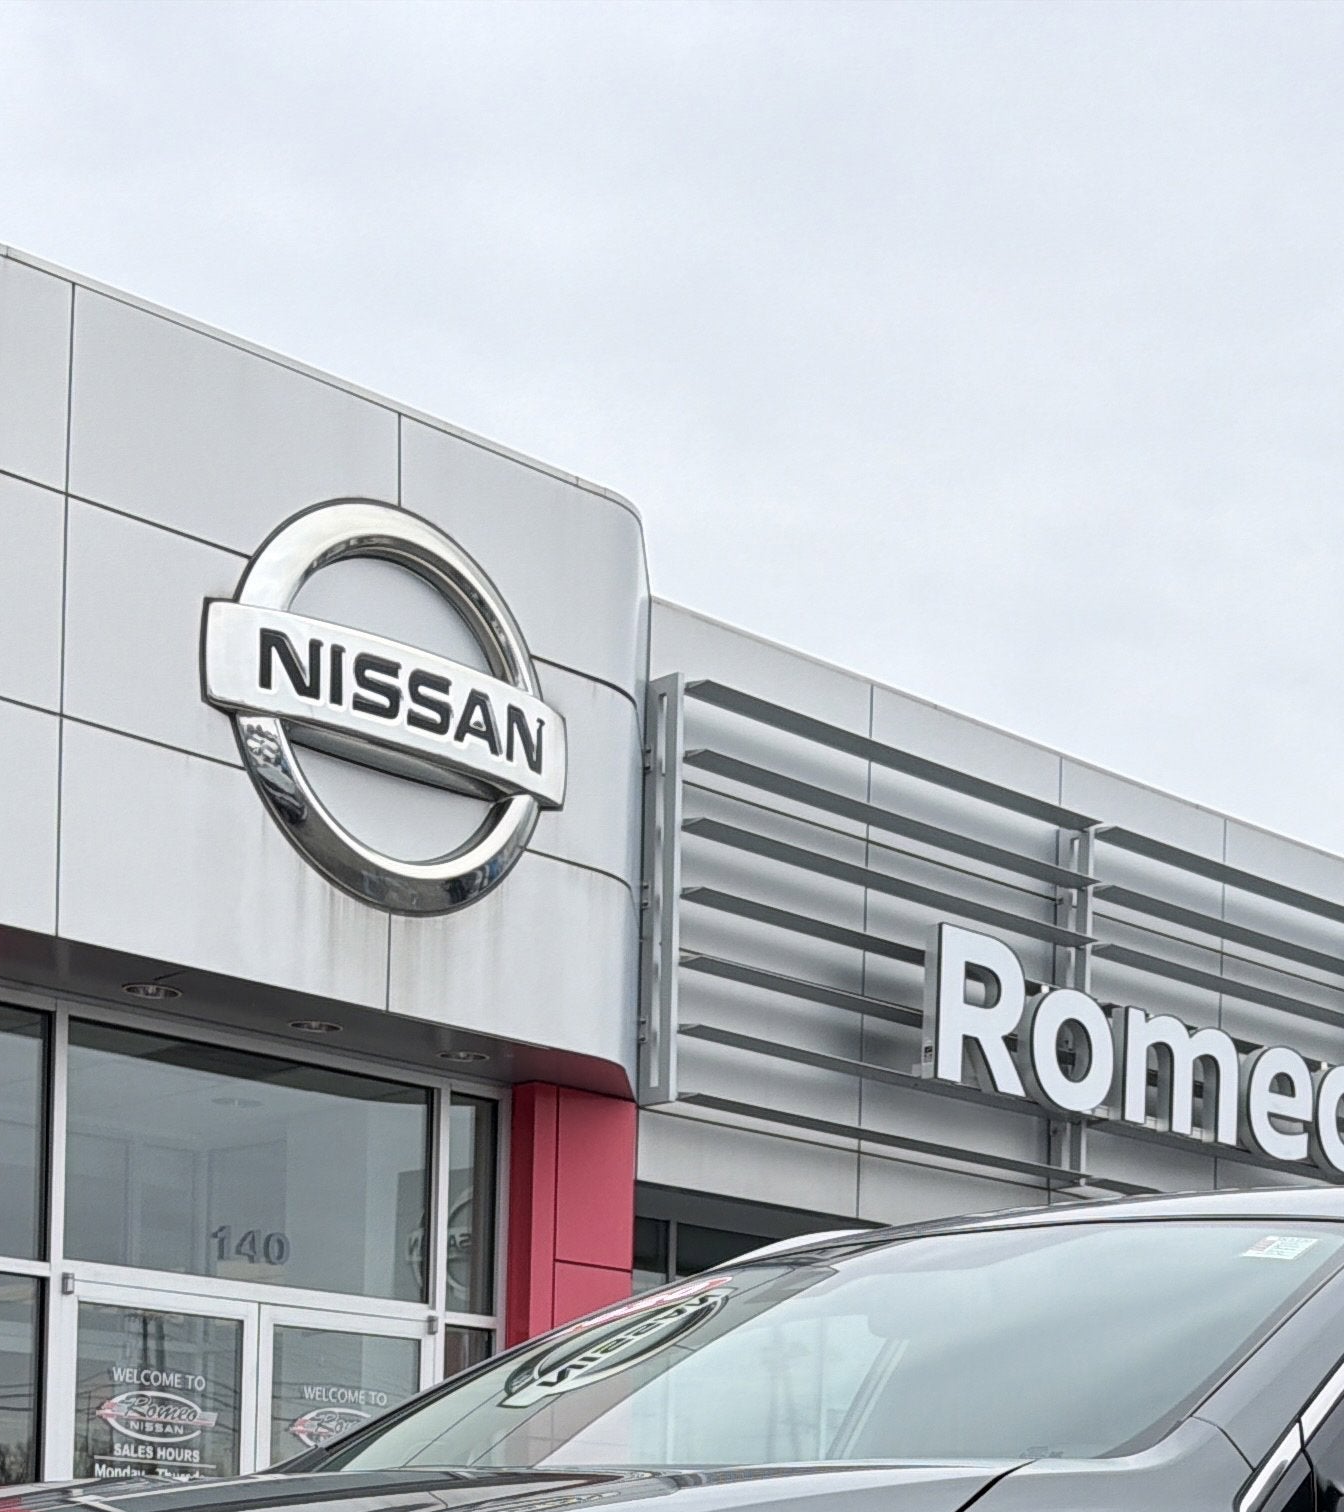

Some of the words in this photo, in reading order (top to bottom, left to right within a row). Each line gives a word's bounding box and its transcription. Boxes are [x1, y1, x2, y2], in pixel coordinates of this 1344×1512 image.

[258, 626, 546, 775] NISSAN
[211, 1225, 290, 1266] 140
[112, 1366, 182, 1389] WELCOME
[184, 1375, 206, 1391] TO
[119, 1393, 199, 1422] Romeo
[303, 1385, 366, 1404] WELCOME
[367, 1392, 387, 1406] TO
[129, 1421, 184, 1435] NISSAN
[113, 1443, 154, 1459] SALES
[156, 1448, 200, 1463] HOURS
